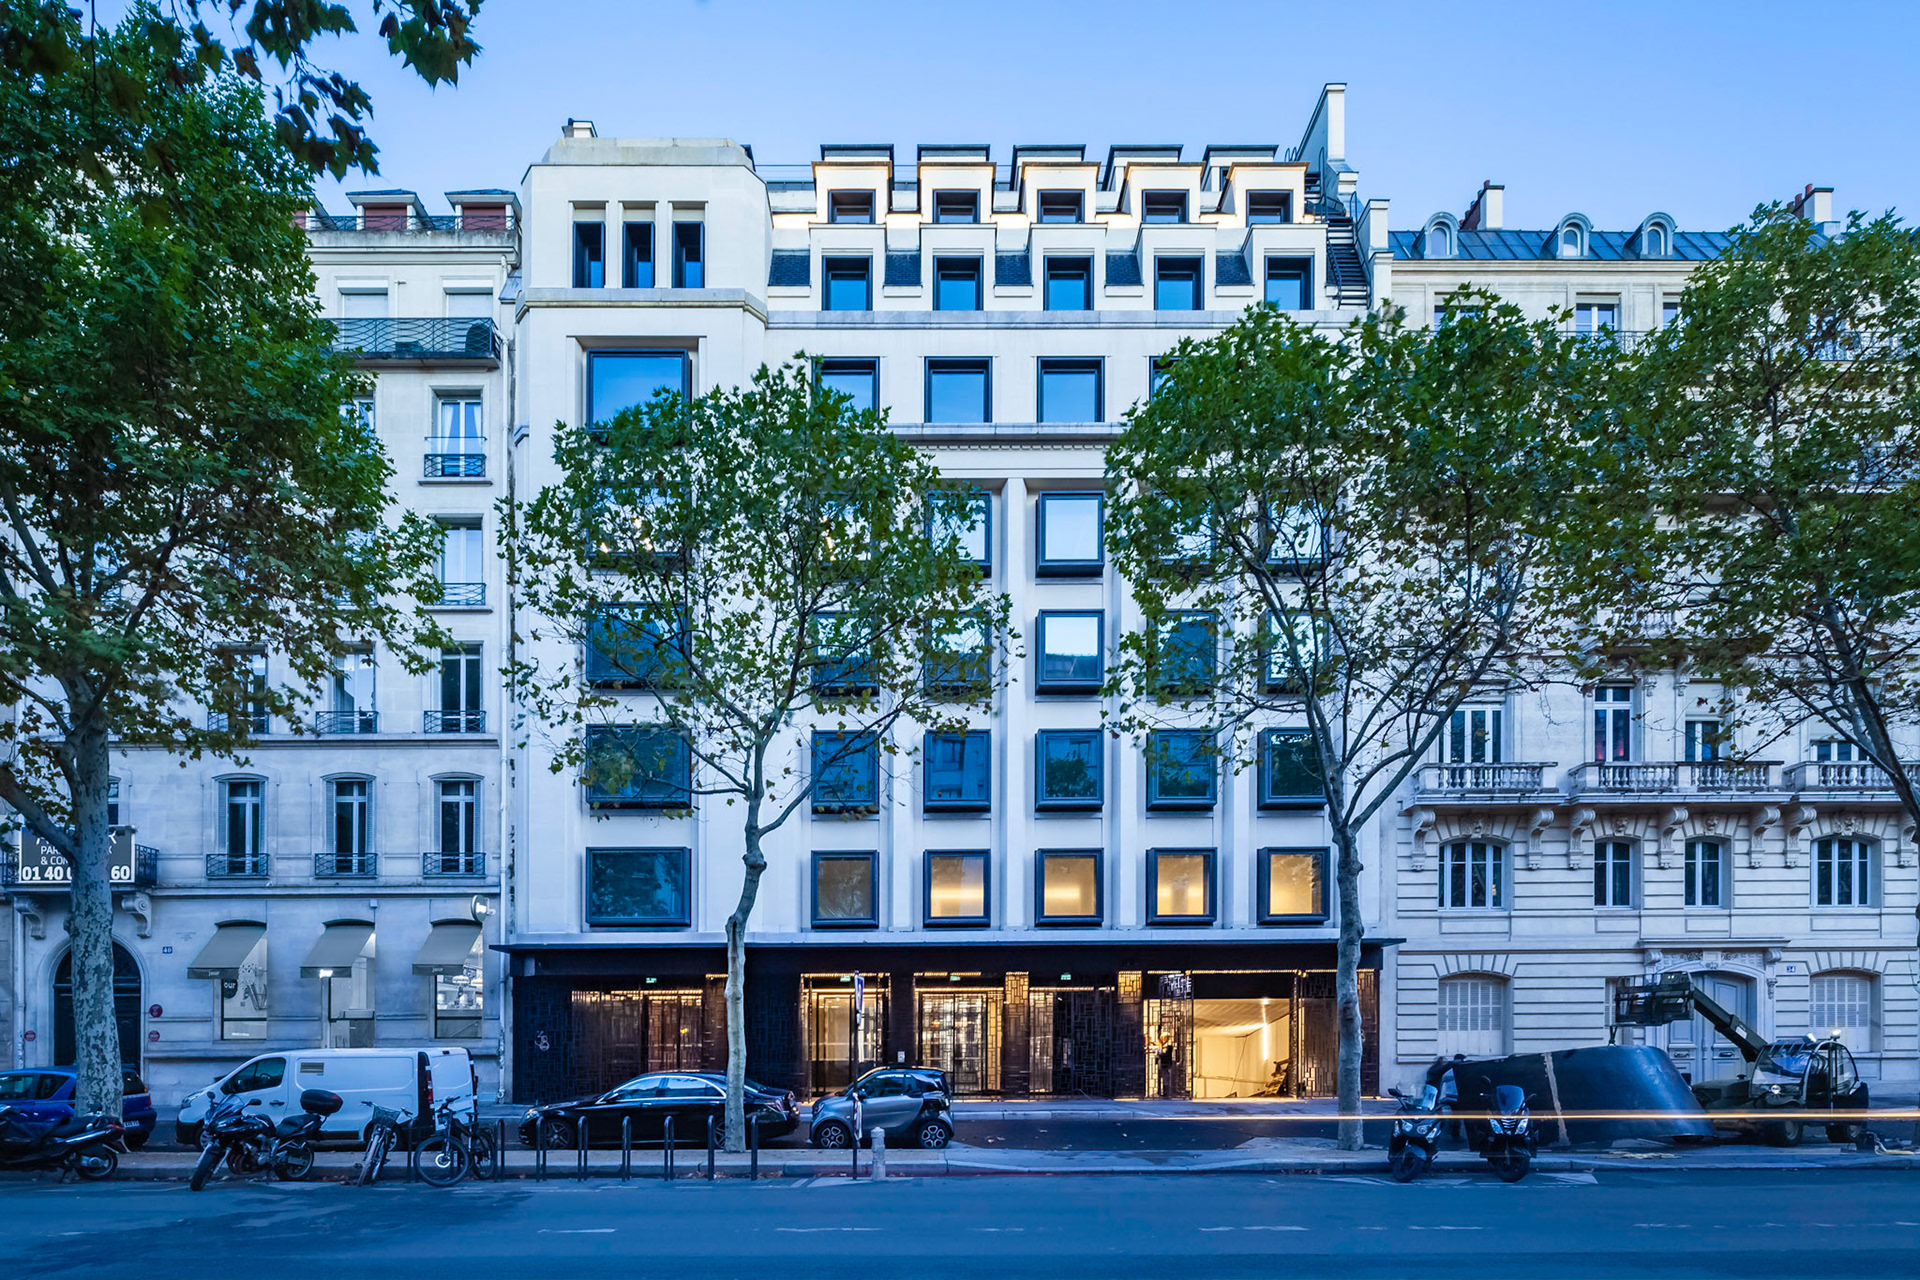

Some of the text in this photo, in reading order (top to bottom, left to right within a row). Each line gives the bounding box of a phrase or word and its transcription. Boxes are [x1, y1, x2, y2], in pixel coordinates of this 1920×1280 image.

[40, 856, 48, 865] &
[22, 866, 41, 880] 01
[44, 866, 64, 880] 40
[111, 865, 130, 880] 60
